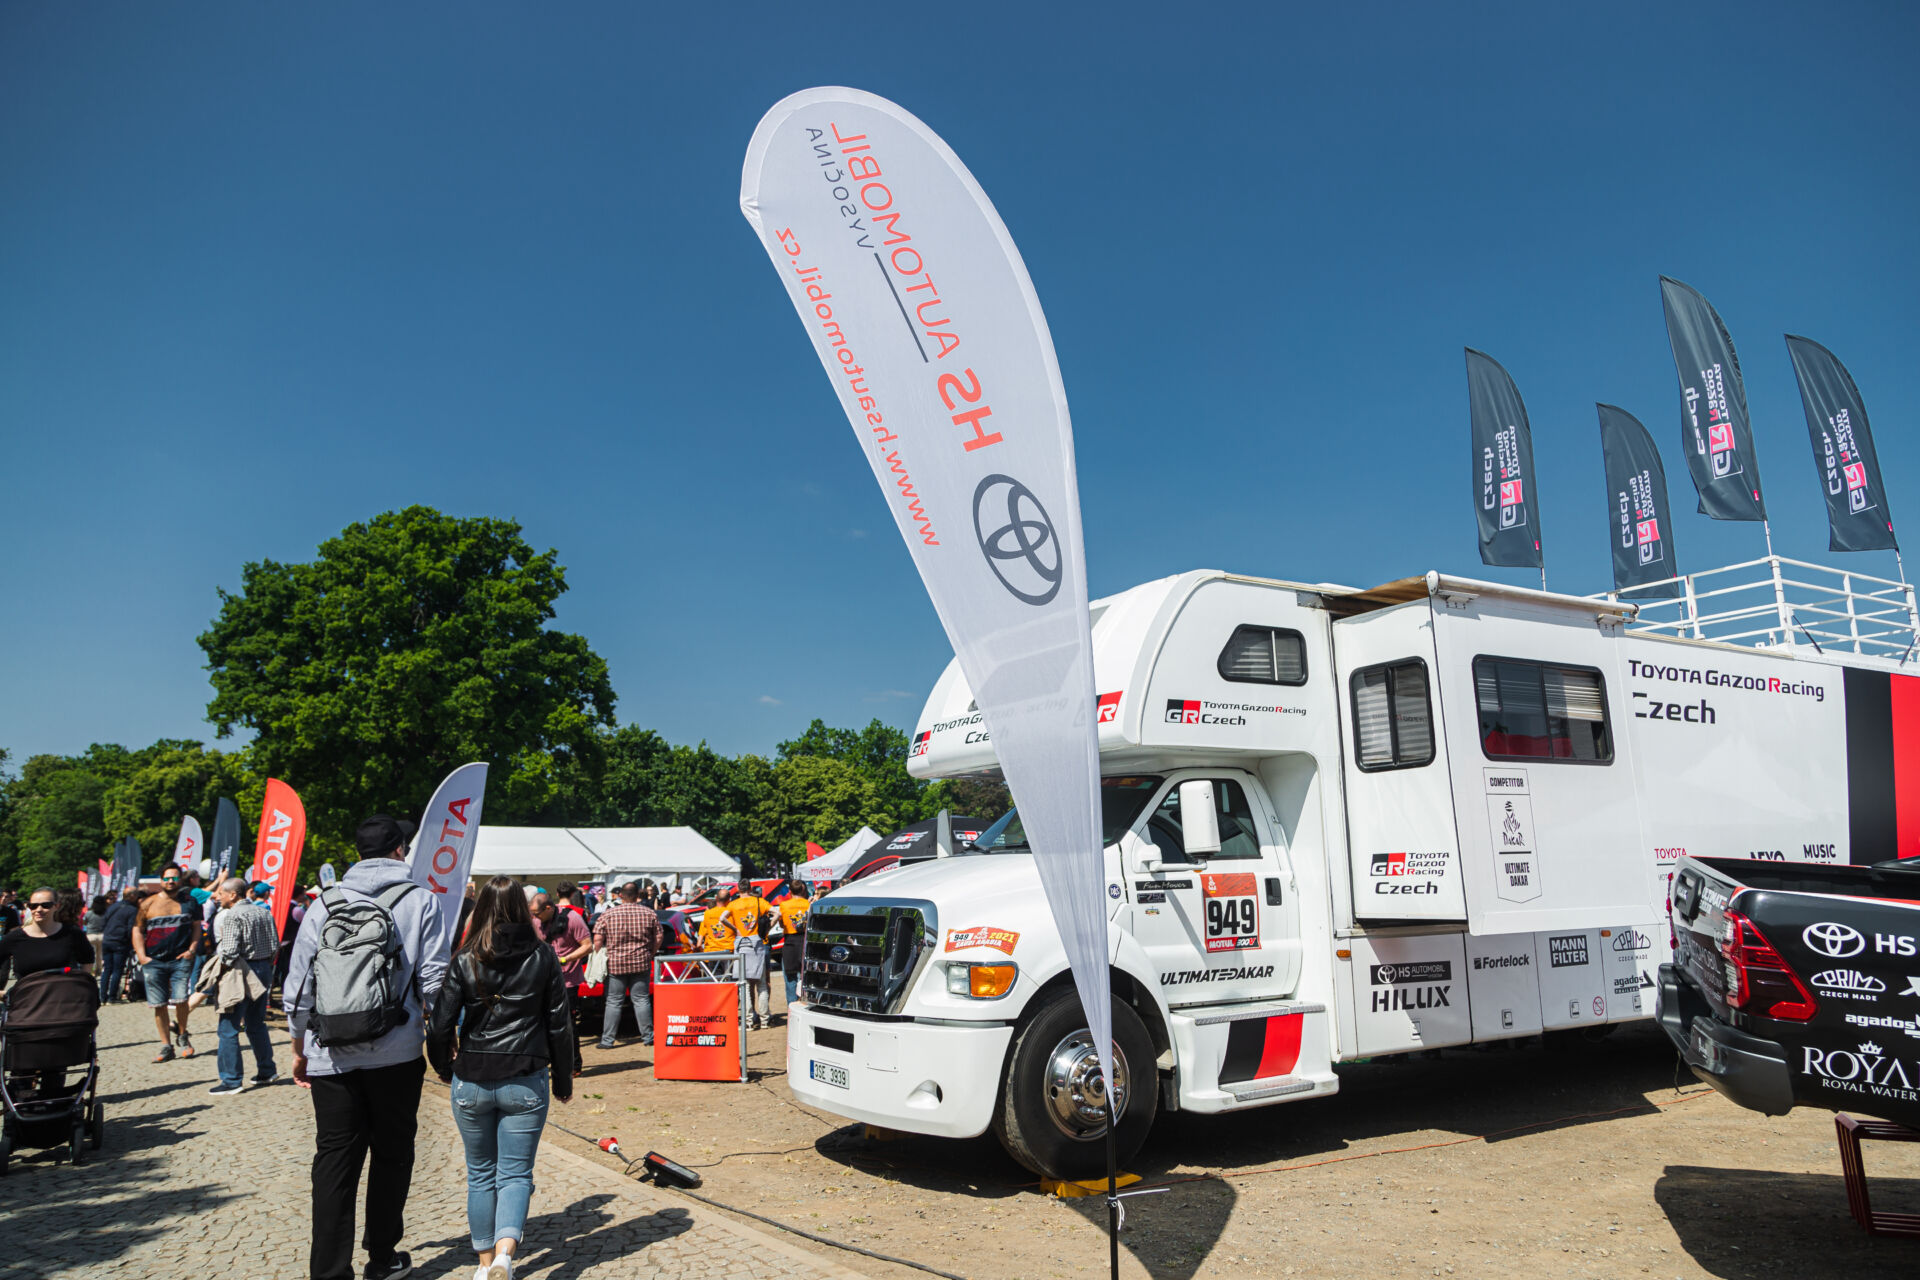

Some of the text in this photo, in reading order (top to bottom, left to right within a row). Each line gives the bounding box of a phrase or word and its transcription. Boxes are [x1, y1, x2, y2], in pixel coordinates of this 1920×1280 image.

[1628, 659, 1825, 702] TOYOTA GAZOO Racing
[1165, 708, 1199, 724] GR
[1203, 701, 1307, 716] TOYOTA GAZOO Racing
[932, 717, 970, 734] TOYOTA
[1201, 714, 1246, 726] Czech
[1489, 777, 1525, 788] COMPETITOR
[1408, 852, 1450, 860] TOYOTA
[1803, 843, 1836, 859] MUSIC
[1371, 861, 1405, 876] GR
[1407, 860, 1446, 868] GAZOO
[1504, 862, 1531, 874] ULTIMATE
[1407, 868, 1445, 877] Racing
[1375, 881, 1438, 894] Czech
[1509, 875, 1529, 887] DAKAR
[1207, 898, 1255, 937] 949
[989, 932, 1015, 943] 2021
[1208, 939, 1235, 949] MOTUL
[1551, 938, 1587, 952] MANN
[1875, 932, 1917, 956] HS
[1482, 953, 1530, 969] Fortelock
[1552, 950, 1588, 965] FILTER
[1398, 964, 1446, 978] HS AUTOMOBIL
[1613, 975, 1644, 987] agados
[1371, 985, 1451, 1013] HILUX
[1819, 990, 1878, 1002] CZECH MADE
[1844, 1013, 1917, 1030] agados
[815, 1063, 846, 1086] 3SE 3939
[1801, 1046, 1920, 1091] ROYA
[1822, 1078, 1918, 1102] ROYAL WATER
